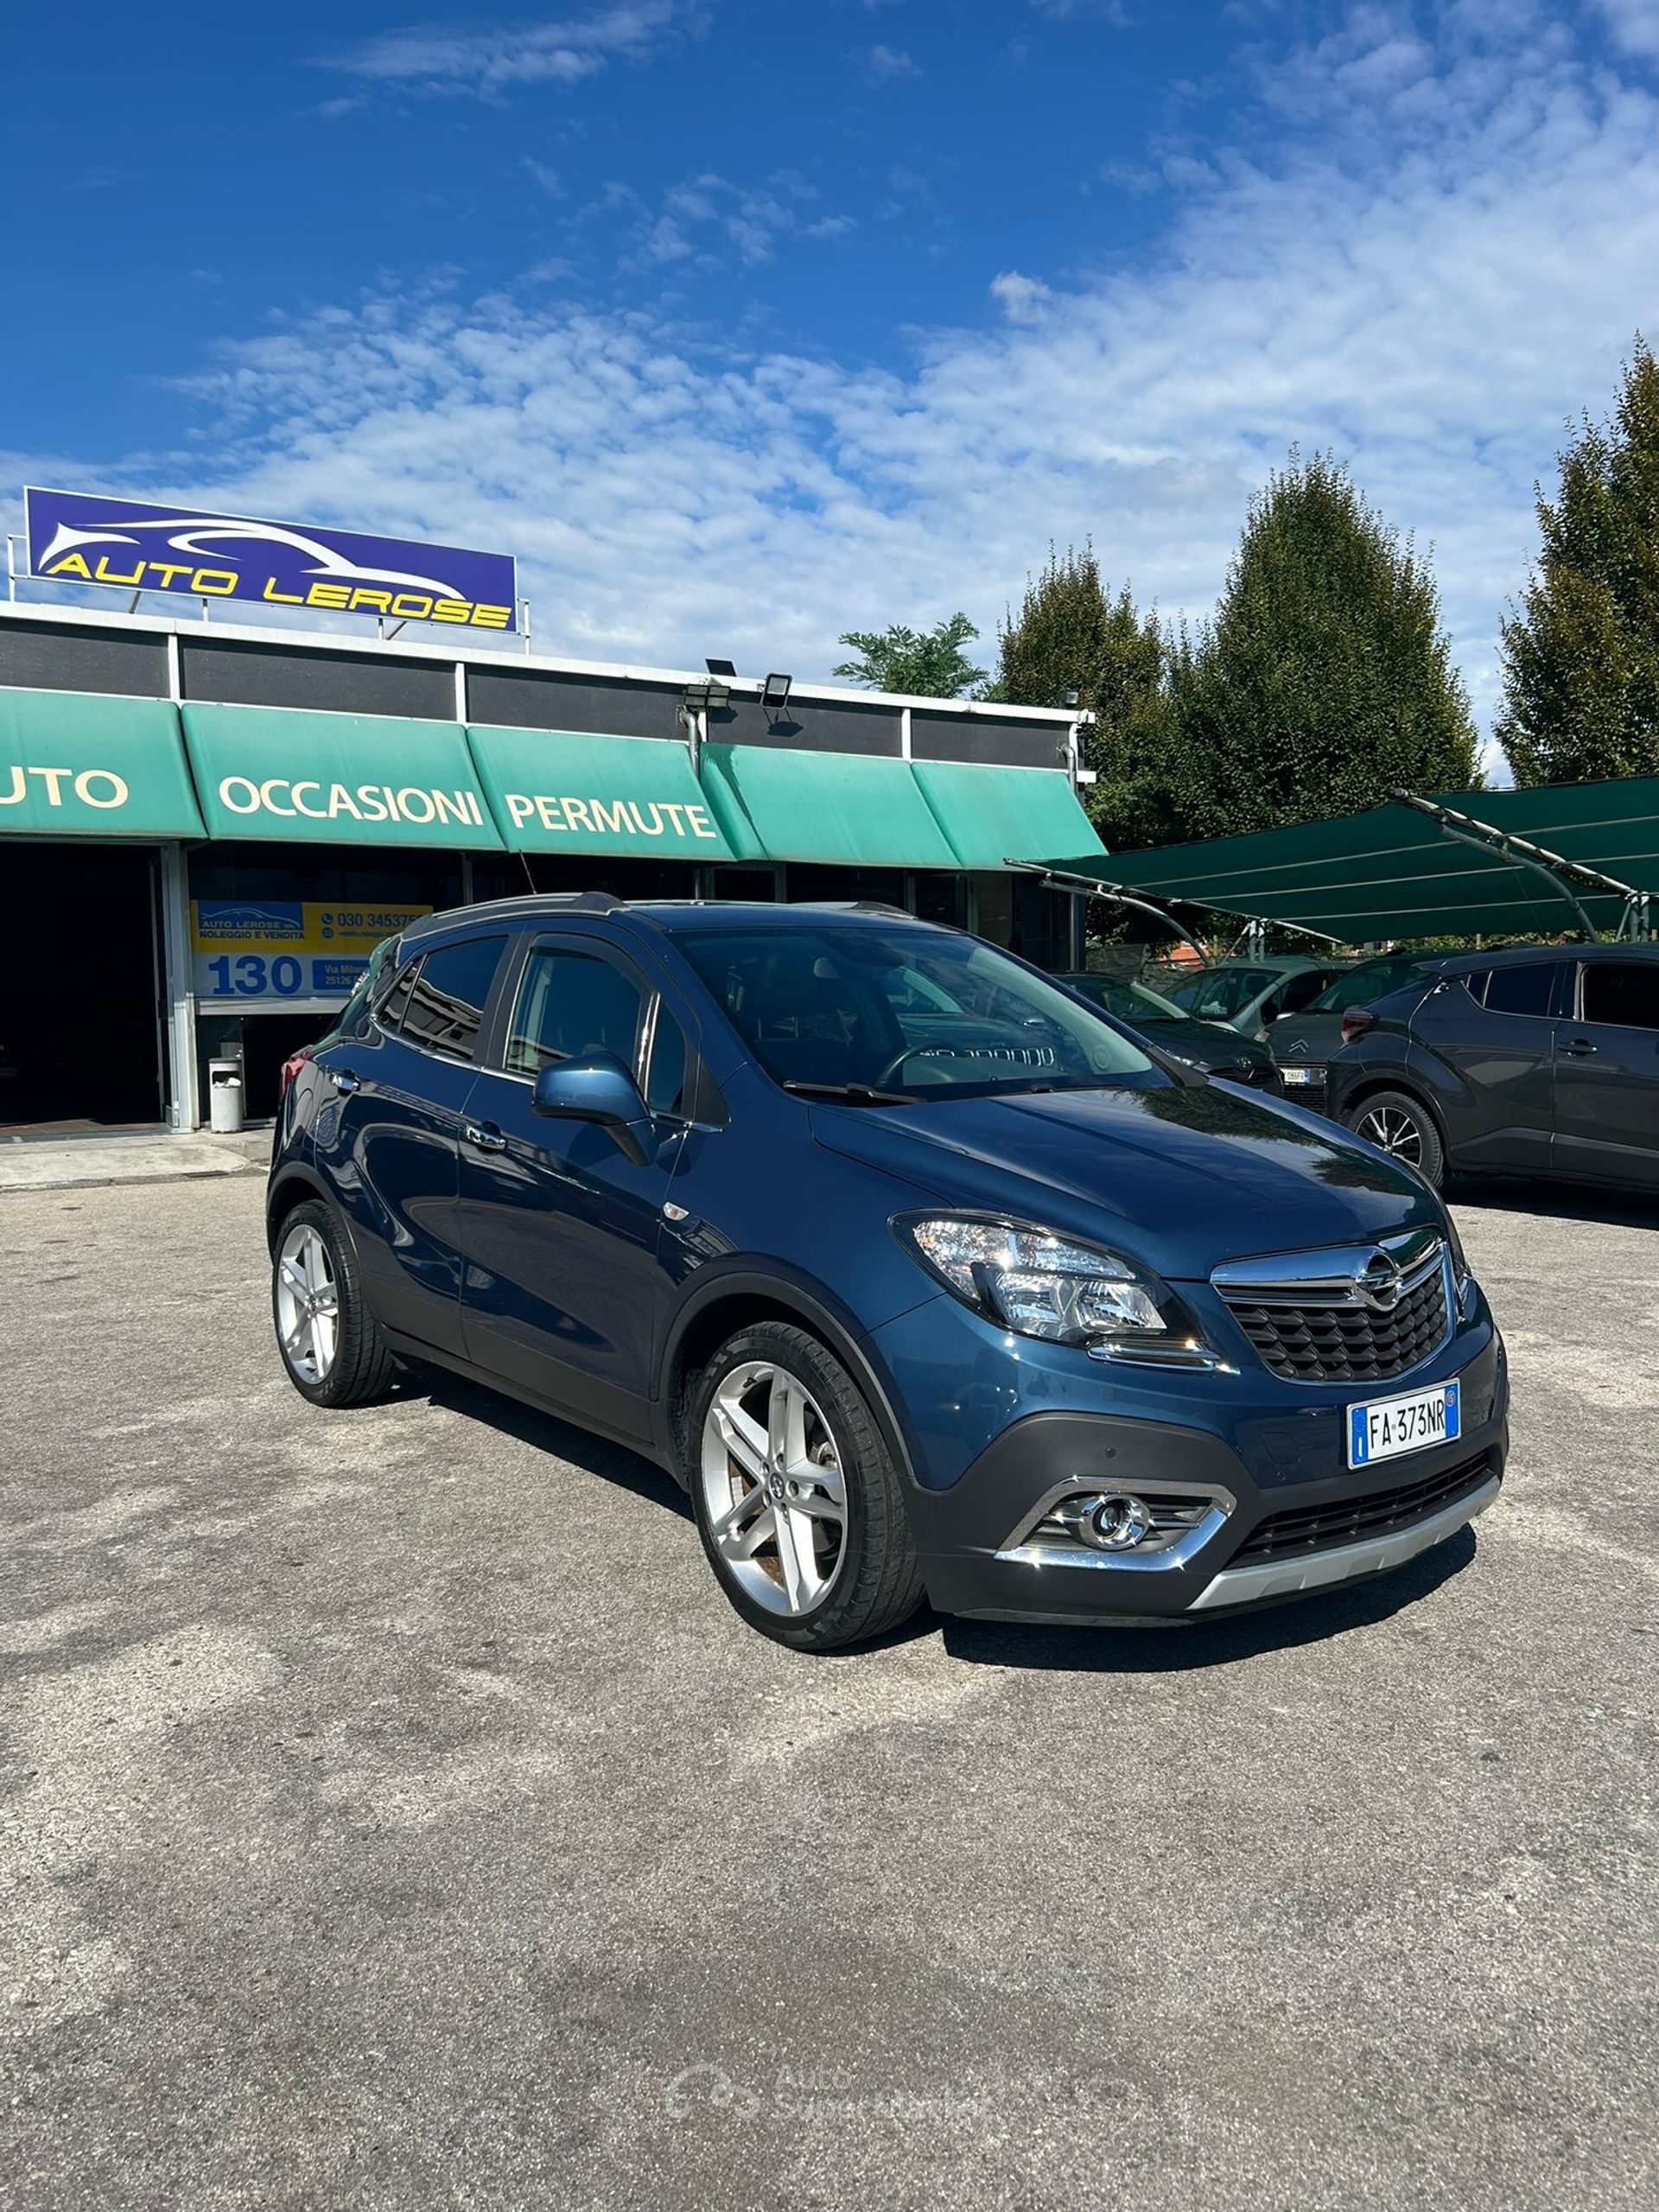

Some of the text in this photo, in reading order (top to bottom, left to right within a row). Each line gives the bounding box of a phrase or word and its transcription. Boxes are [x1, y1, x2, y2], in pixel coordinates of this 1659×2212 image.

[45, 552, 512, 628] AUTO LEROSE
[219, 775, 484, 825] OCCASIONI
[505, 793, 717, 838] PERMUTE
[236, 920, 281, 929] LEROSE
[338, 912, 364, 927] 030
[200, 931, 305, 939] NOLEGGIO E VENDITA
[207, 955, 302, 995] 130
[325, 965, 339, 974] Via
